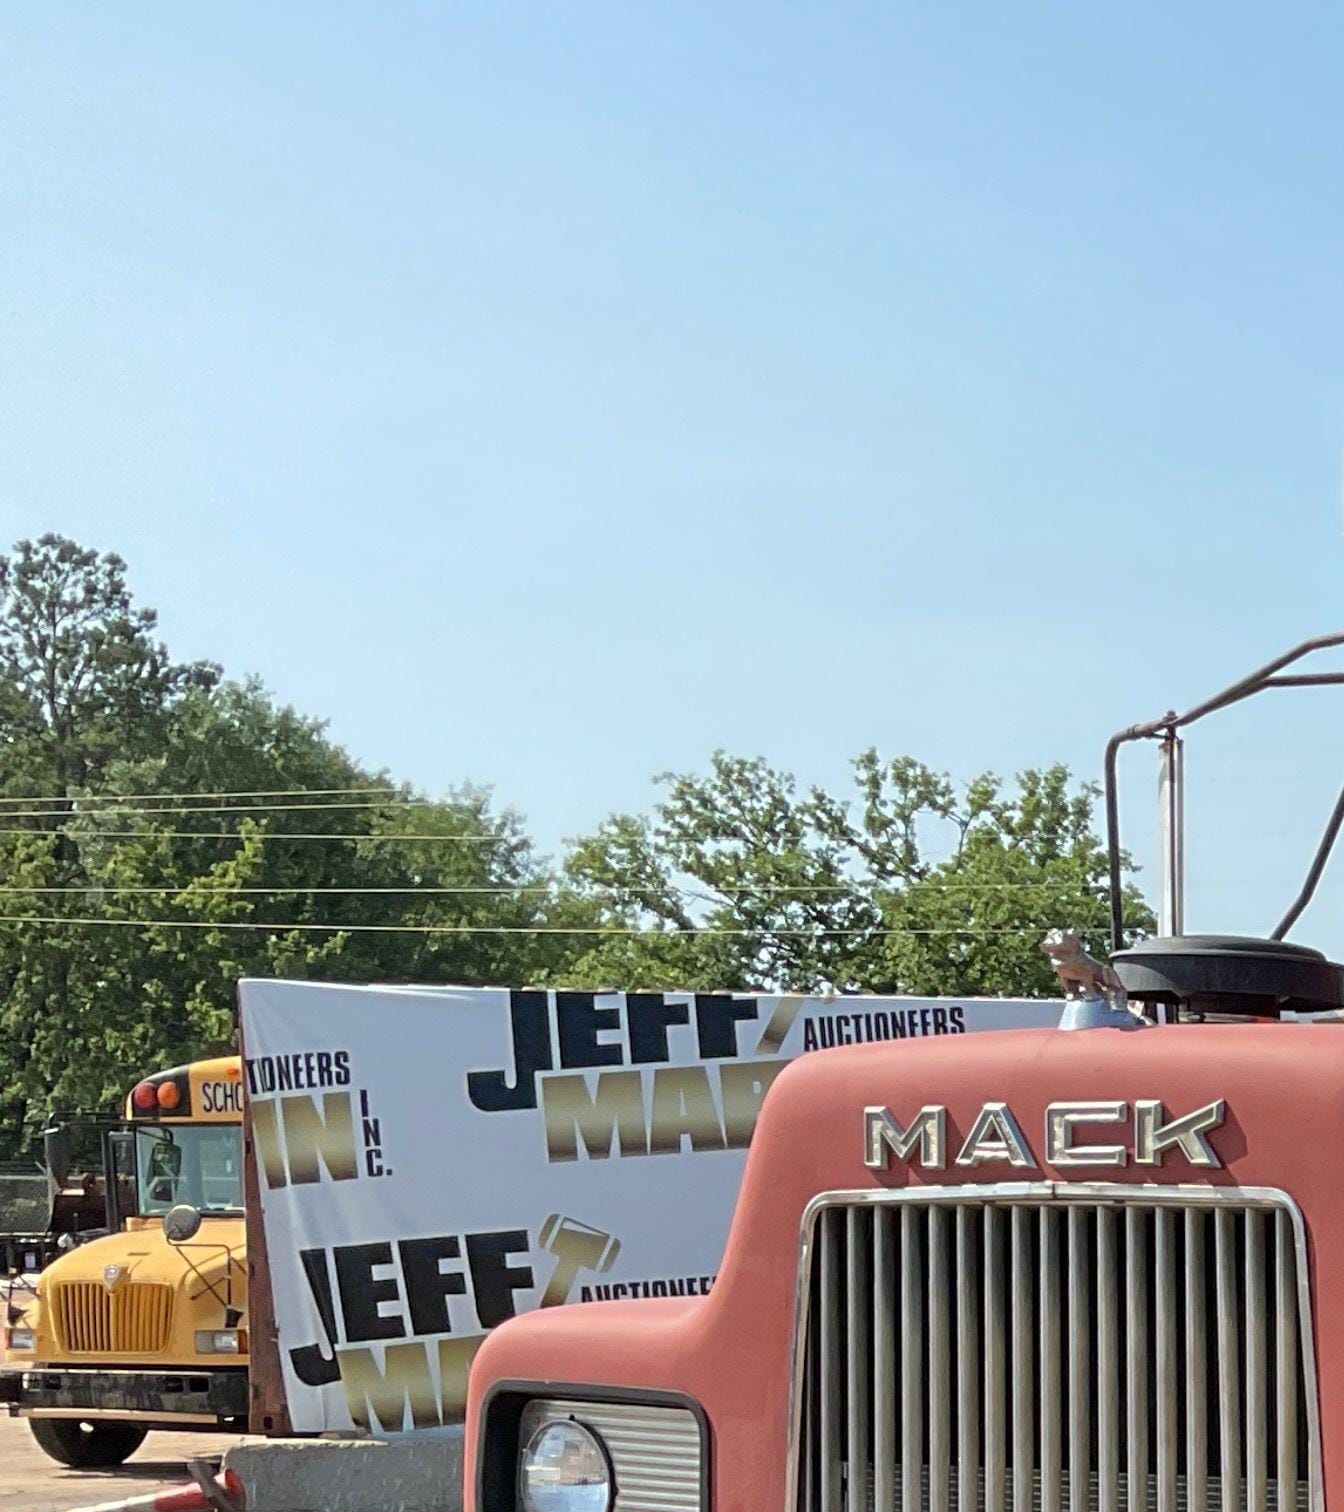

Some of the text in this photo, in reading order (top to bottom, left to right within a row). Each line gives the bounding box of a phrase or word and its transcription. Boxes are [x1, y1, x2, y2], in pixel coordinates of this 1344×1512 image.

[803, 1006, 966, 1052] AUCTIONEERS
[863, 1099, 1225, 1171] MACK
[289, 1230, 535, 1386] JEFF
